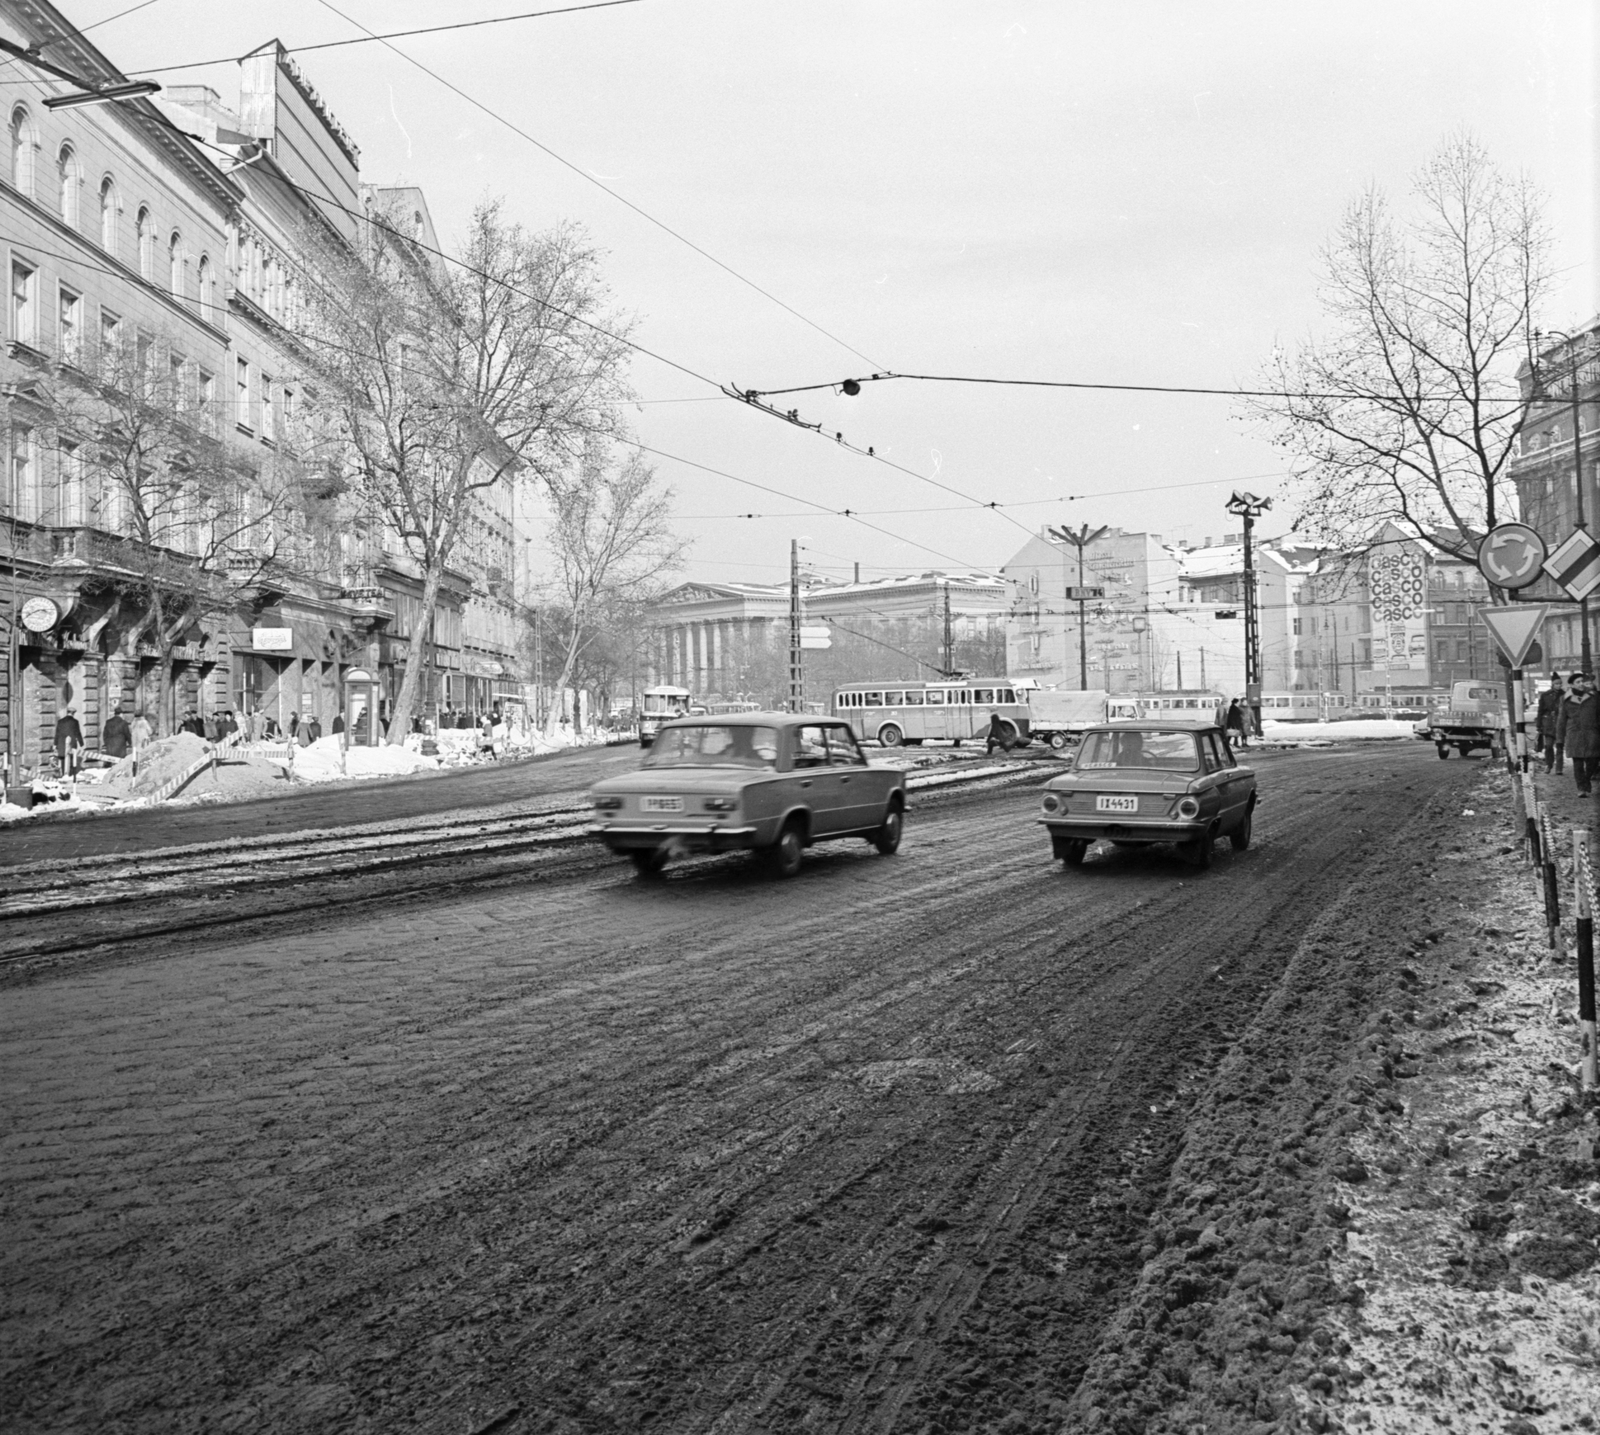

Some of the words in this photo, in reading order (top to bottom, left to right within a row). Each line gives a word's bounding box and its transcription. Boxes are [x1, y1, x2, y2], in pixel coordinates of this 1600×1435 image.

[1372, 552, 1420, 570] casco
[1372, 565, 1422, 583] casco
[1372, 579, 1423, 596] casco
[1373, 592, 1423, 609] casco
[1373, 606, 1423, 622] casco
